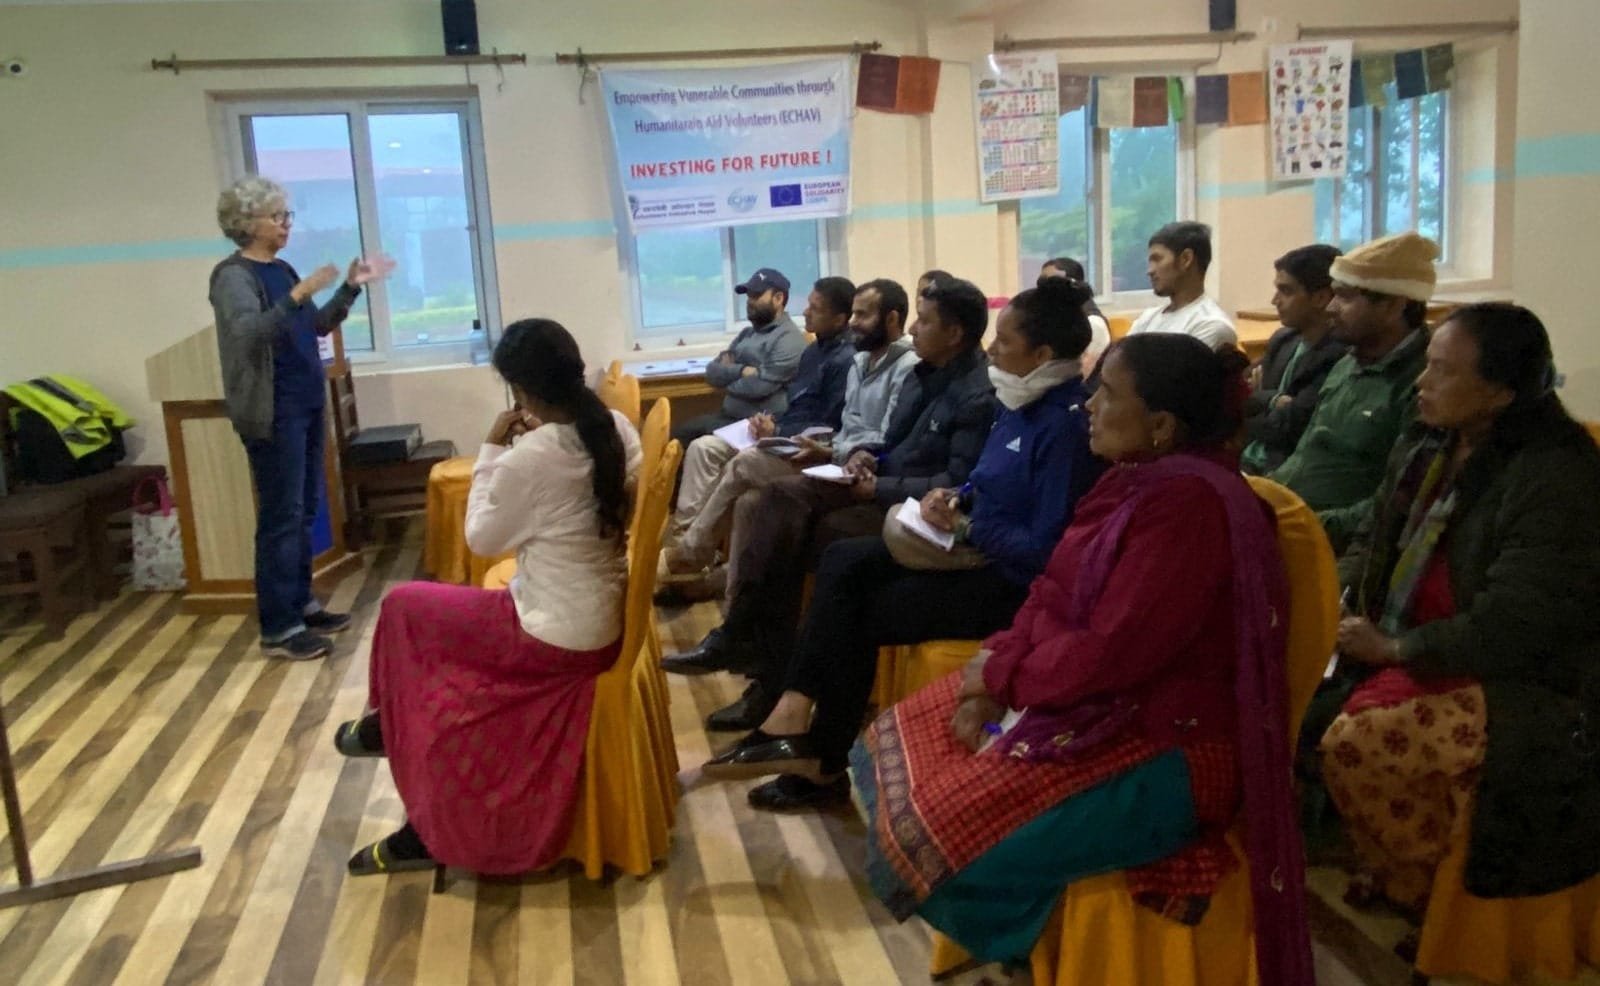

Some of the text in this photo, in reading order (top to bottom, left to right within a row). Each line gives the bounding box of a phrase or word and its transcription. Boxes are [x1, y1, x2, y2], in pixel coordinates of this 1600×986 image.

[614, 77, 835, 107] Empowering Vunerable Communities through
[706, 114, 722, 129] Aid
[724, 112, 778, 128] Volunteers
[779, 107, 821, 125] (ECHAV)
[631, 159, 715, 179] INVESTING
[722, 155, 753, 172] FOR
[760, 150, 820, 168] FUTURE
